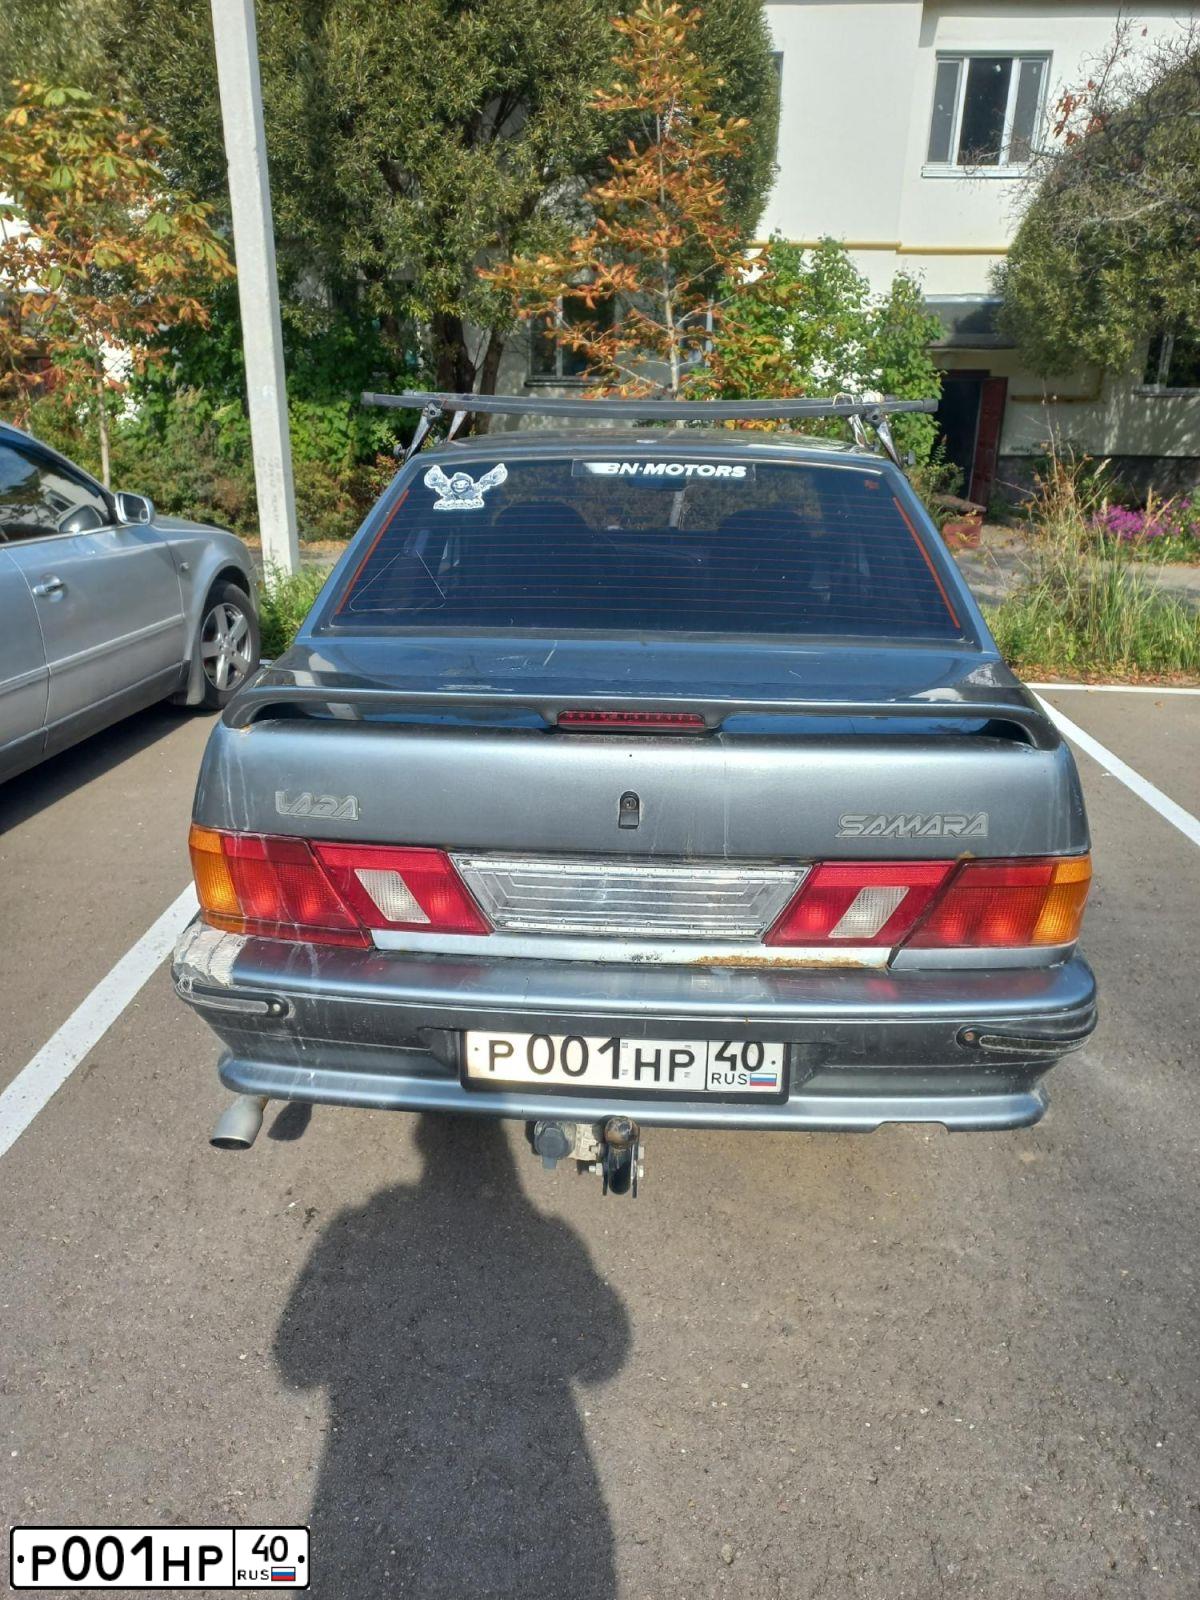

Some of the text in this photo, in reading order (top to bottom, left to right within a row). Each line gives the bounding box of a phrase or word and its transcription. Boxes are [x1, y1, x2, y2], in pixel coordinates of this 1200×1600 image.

[275, 791, 359, 821] LADA
[835, 812, 989, 839] SAMARA
[714, 1040, 765, 1072] 40
[711, 1072, 748, 1085] RUS
